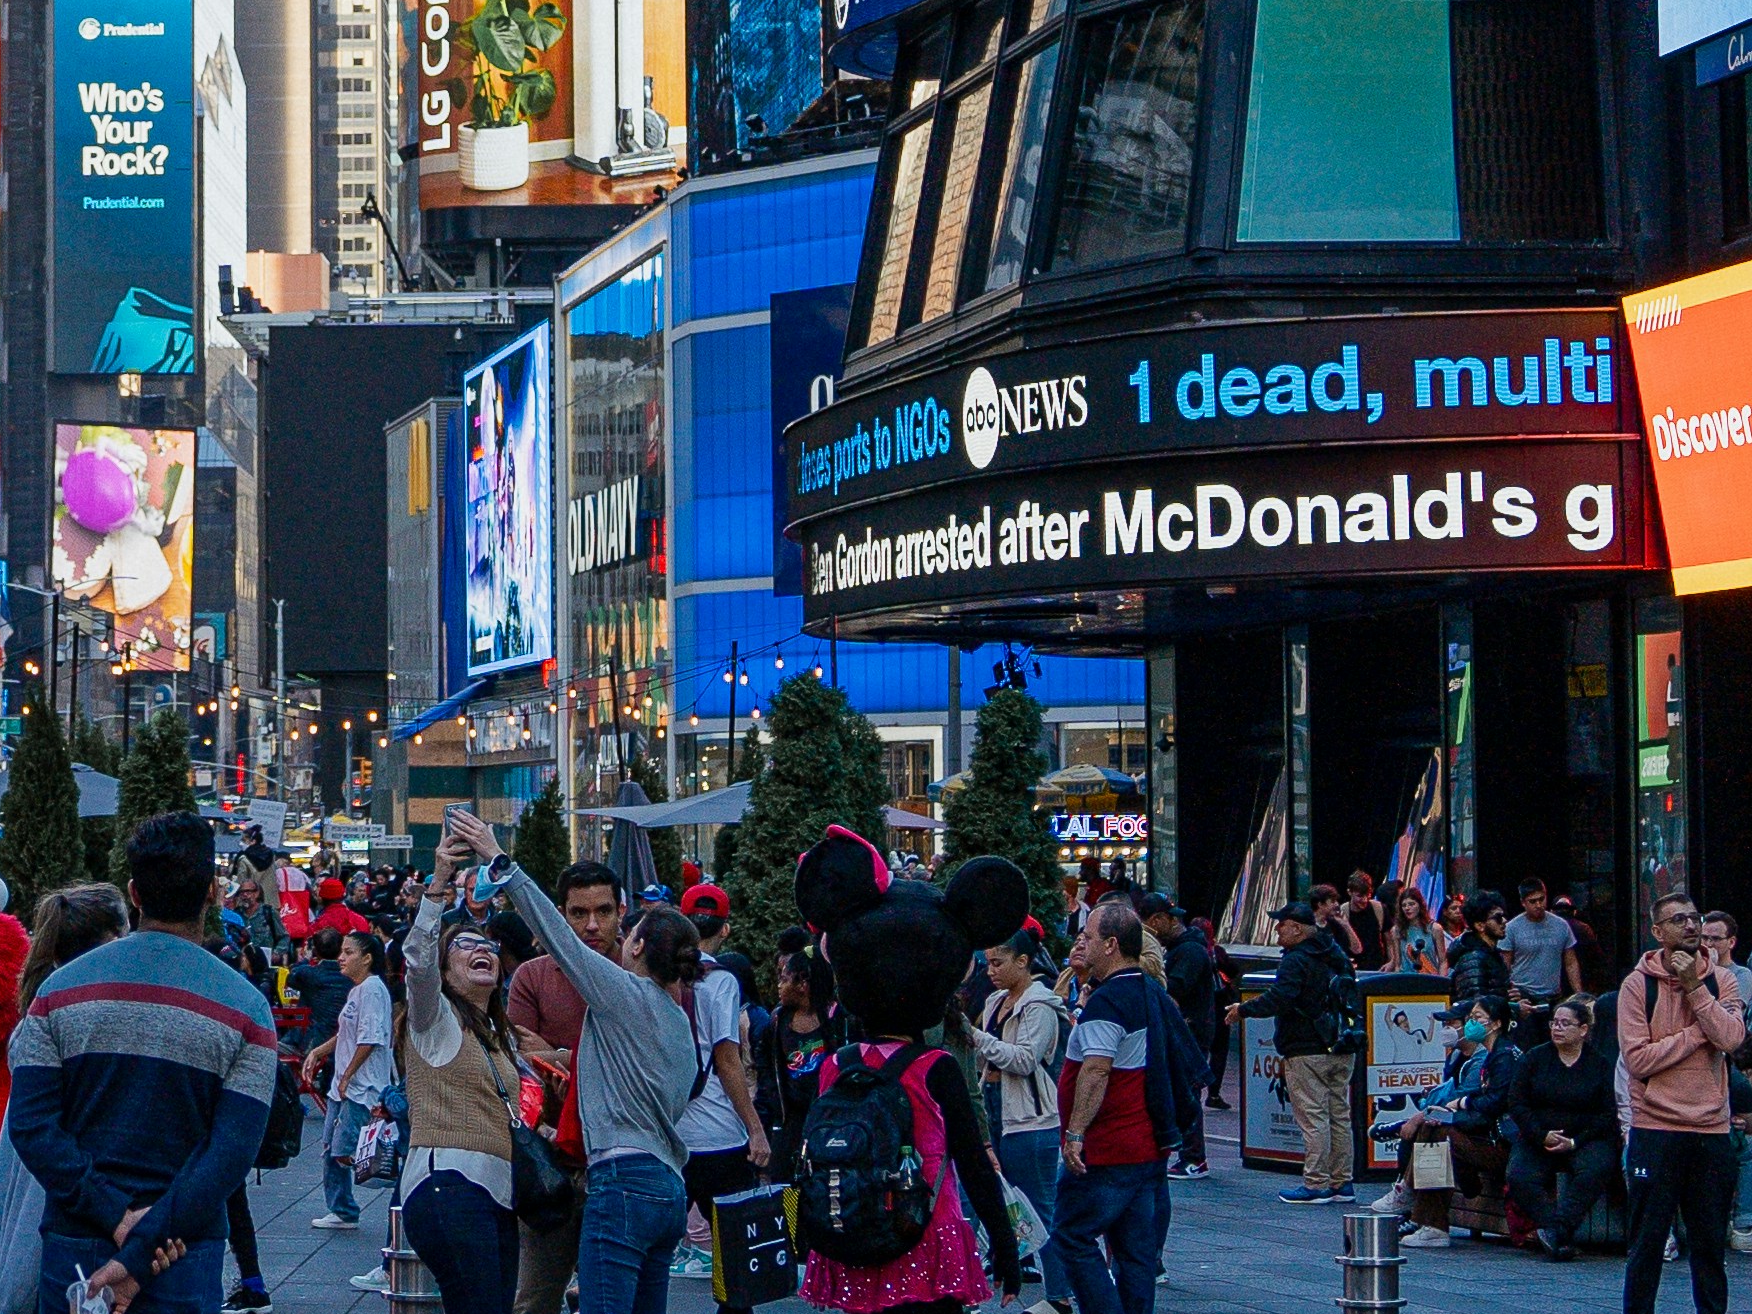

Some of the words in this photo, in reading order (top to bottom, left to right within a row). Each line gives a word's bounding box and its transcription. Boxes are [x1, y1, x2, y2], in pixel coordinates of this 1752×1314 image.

[103, 22, 165, 36] Prudential
[78, 82, 165, 113] Who's
[421, 90, 452, 152] LG
[90, 114, 153, 144] Your
[82, 145, 170, 176] Rock?
[83, 197, 165, 209] Prudential.com
[966, 408, 997, 434] abc
[998, 375, 1088, 436] NEWS
[1128, 360, 1153, 423] 1
[1175, 346, 1384, 424] dead,
[1415, 336, 1613, 408] multi
[798, 443, 832, 495] loses
[833, 431, 870, 495] ports
[873, 426, 891, 469] to
[895, 396, 951, 467] NGOs
[1652, 403, 1752, 462] Discover
[568, 493, 595, 576] OLD
[595, 474, 639, 567] NAVY
[835, 526, 892, 591] Gordon
[894, 517, 992, 581] arrested
[998, 499, 1089, 572] after
[1104, 470, 1538, 557] McDonald's
[1565, 484, 1613, 550] g
